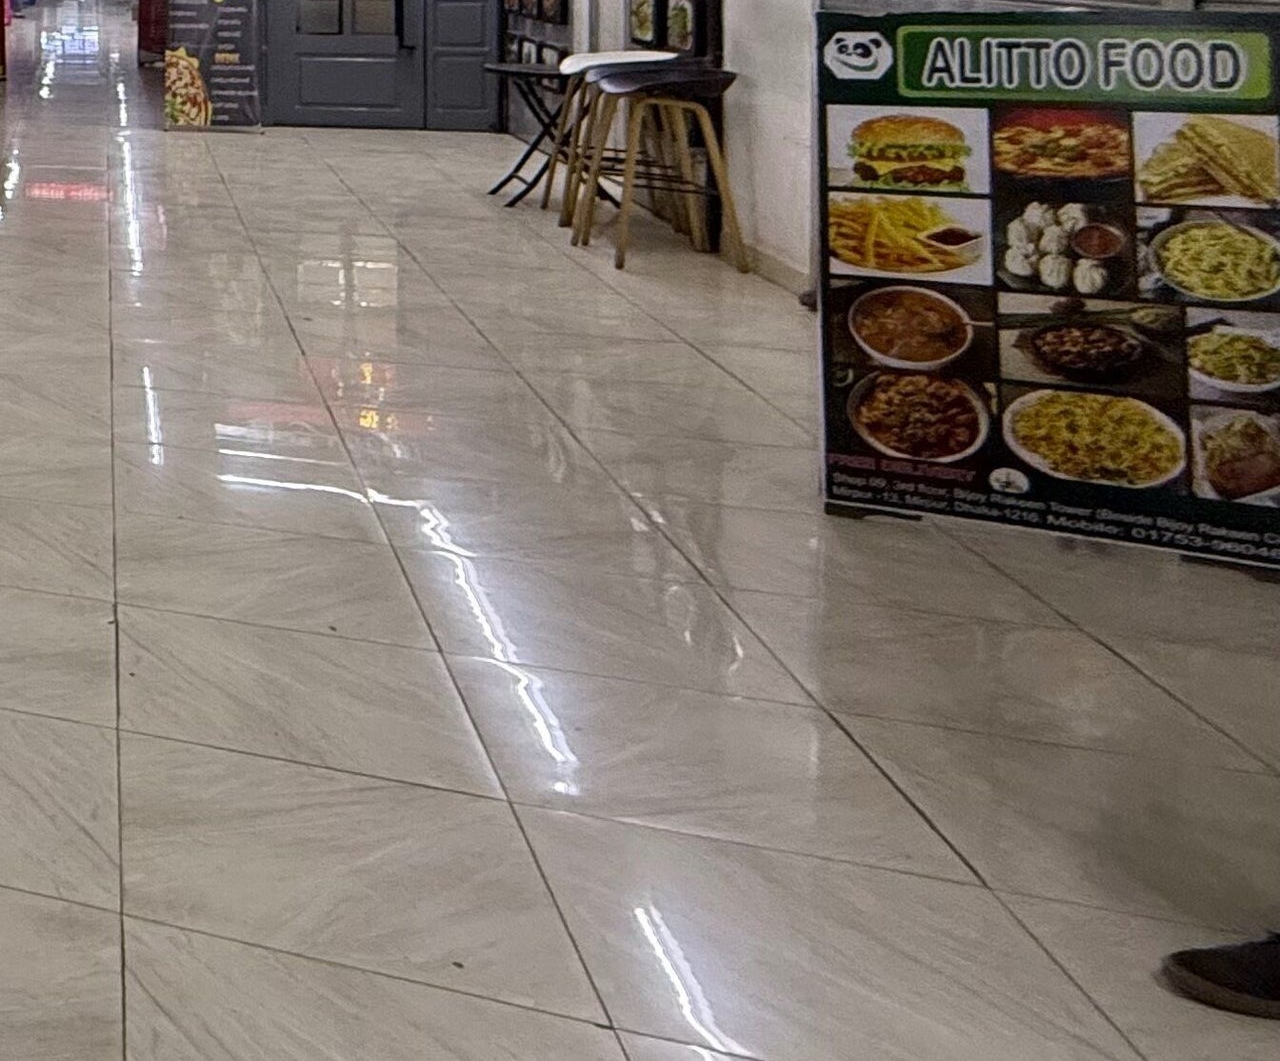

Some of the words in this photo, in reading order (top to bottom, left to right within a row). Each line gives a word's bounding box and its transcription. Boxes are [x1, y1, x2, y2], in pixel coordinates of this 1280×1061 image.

[921, 36, 1093, 90] ALITTO
[1098, 38, 1248, 92] FOOD
[832, 472, 867, 487] Shop
